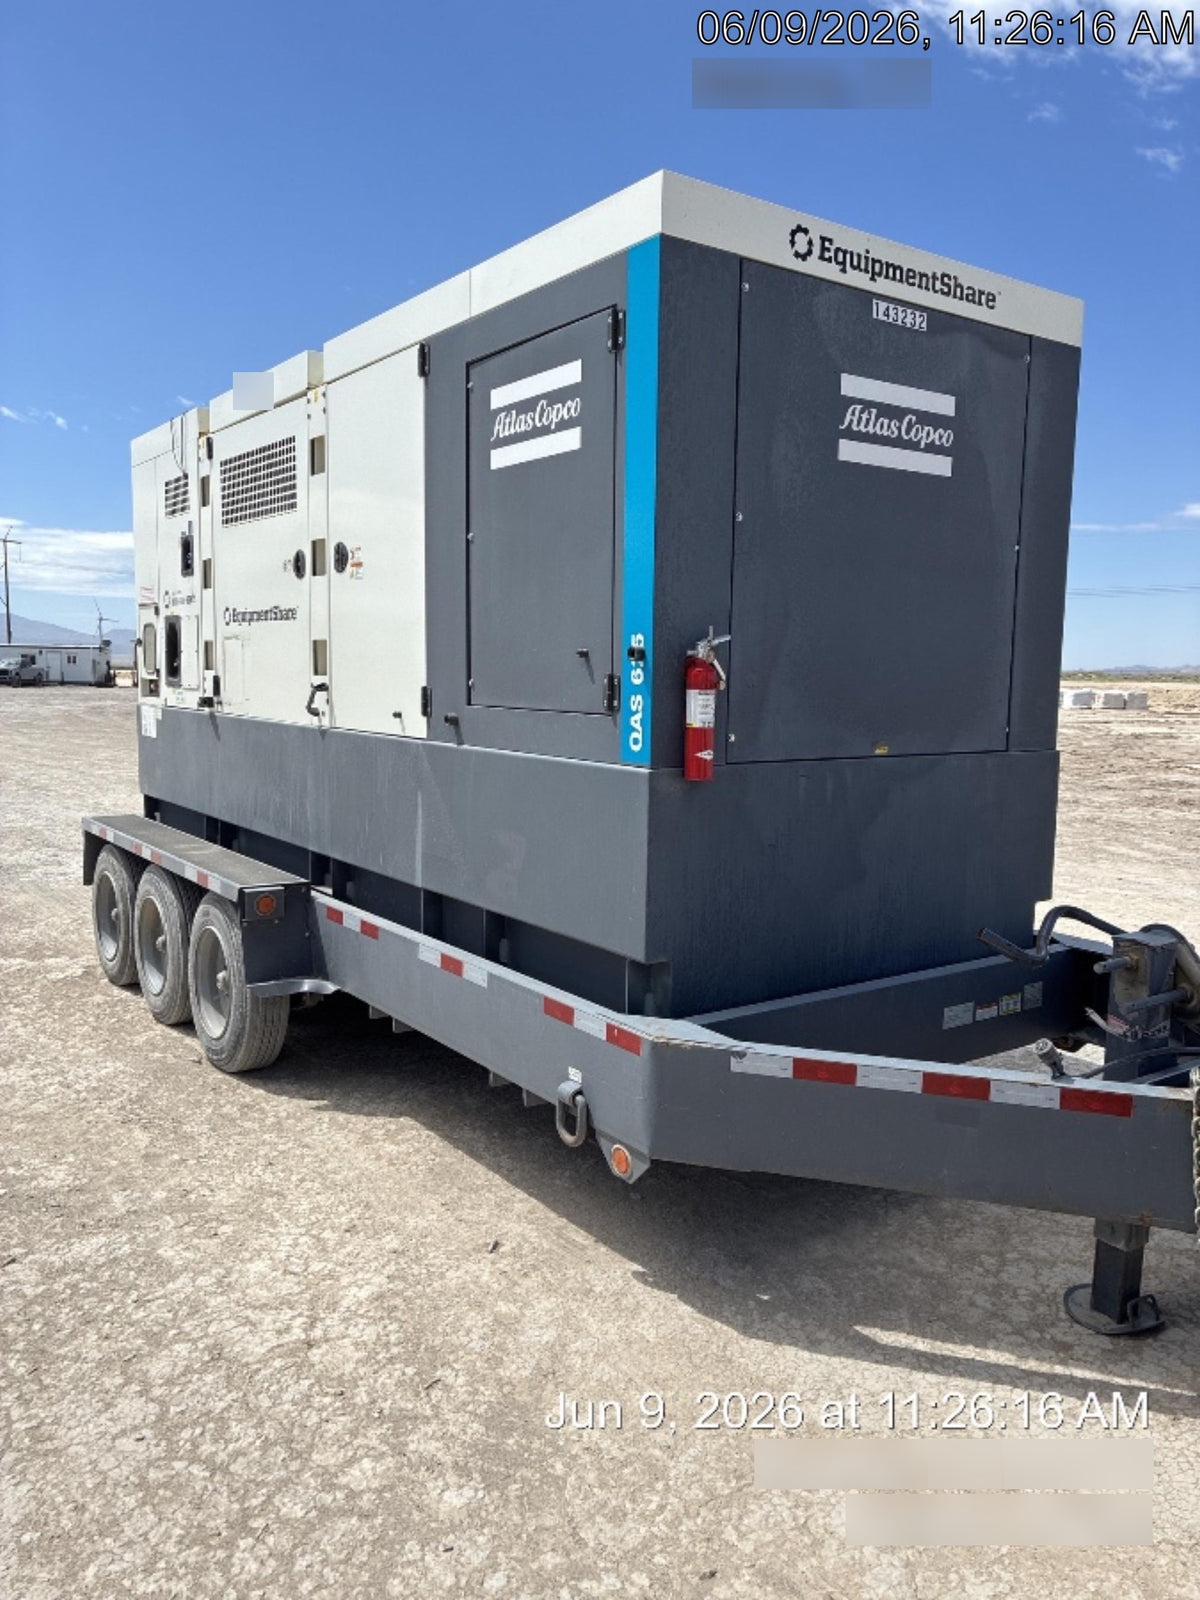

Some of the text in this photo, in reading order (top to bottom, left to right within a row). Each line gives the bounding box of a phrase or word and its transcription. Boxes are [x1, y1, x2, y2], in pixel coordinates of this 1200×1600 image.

[817, 234, 997, 310] EquipmentShare
[873, 301, 927, 330] 143232
[490, 398, 581, 441] Atlas Copco
[839, 404, 954, 448] Atlas Copco
